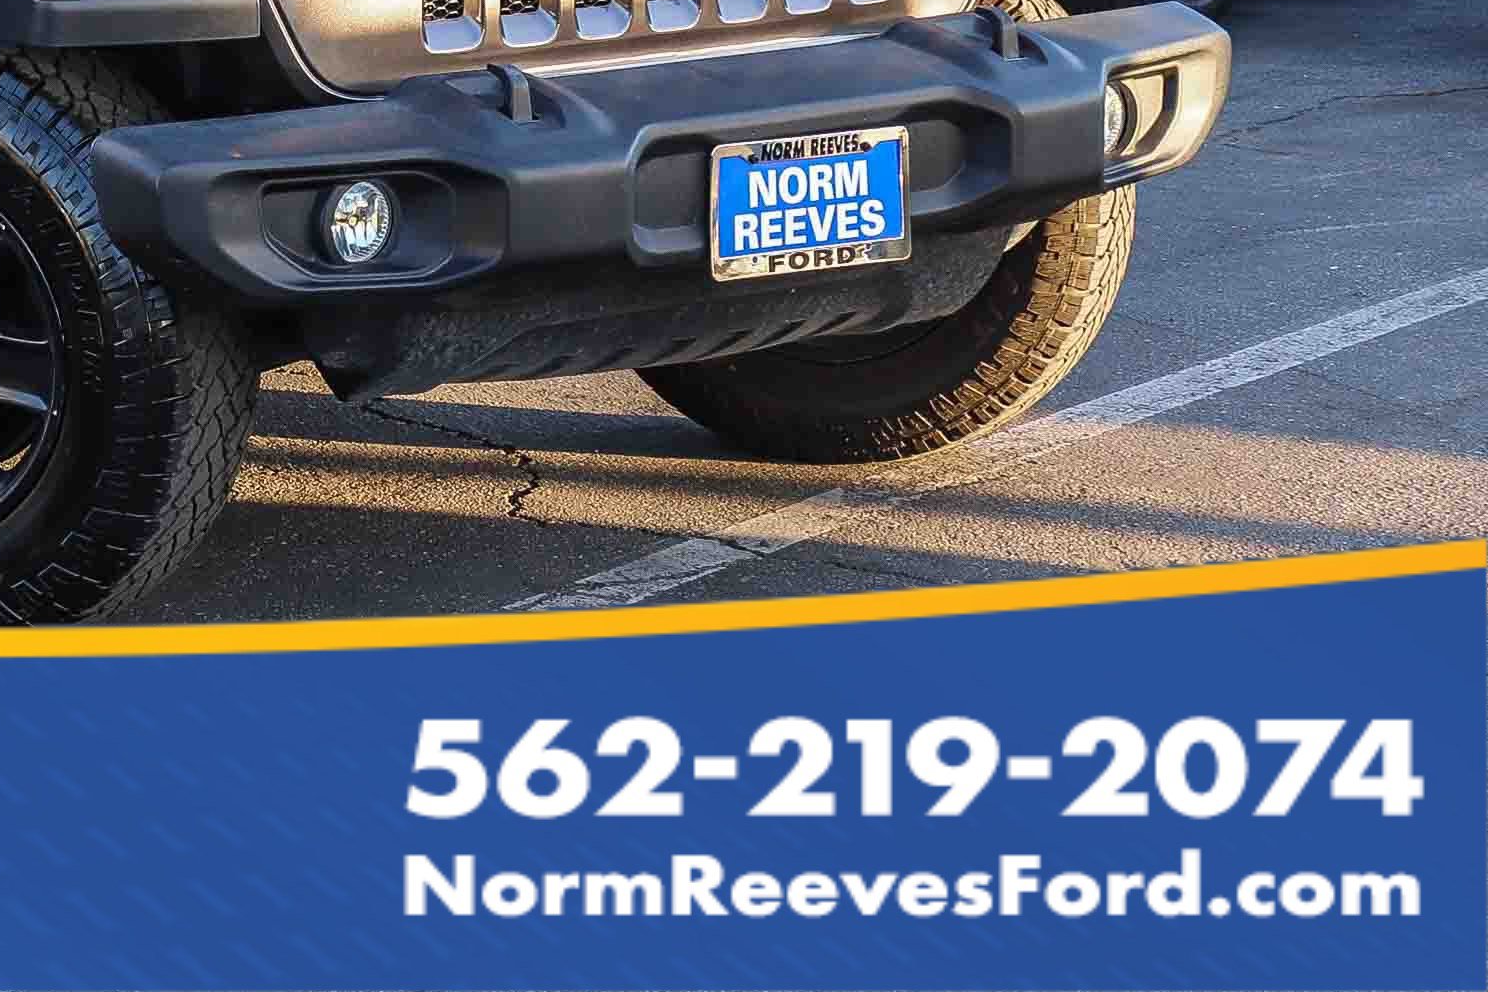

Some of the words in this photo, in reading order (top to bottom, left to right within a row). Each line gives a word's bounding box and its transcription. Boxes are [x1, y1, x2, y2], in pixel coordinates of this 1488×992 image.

[761, 140, 805, 160] NORM
[811, 134, 859, 155] REEVES
[748, 160, 868, 208] NORM
[733, 199, 886, 251] REEVES
[768, 246, 857, 273] FORD
